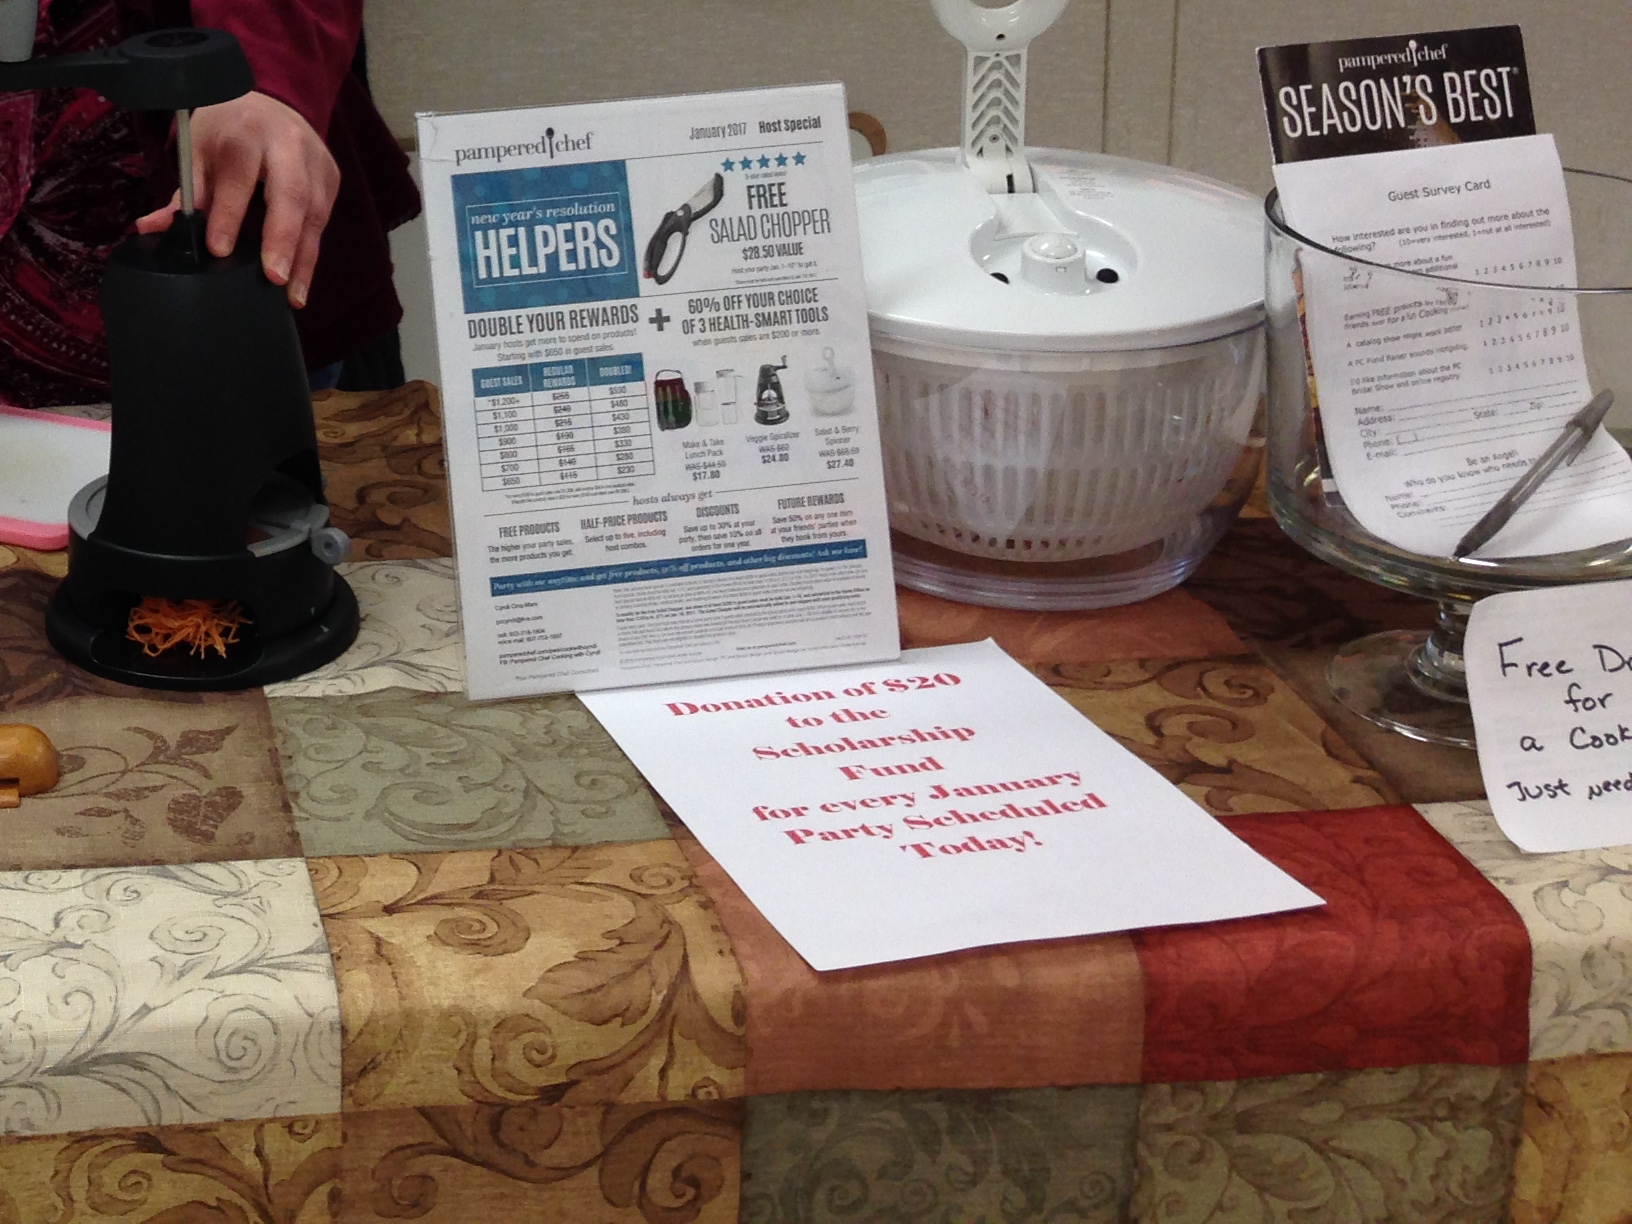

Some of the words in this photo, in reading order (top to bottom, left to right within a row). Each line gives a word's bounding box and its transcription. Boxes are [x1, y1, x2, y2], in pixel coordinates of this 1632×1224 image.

[1338, 46, 1413, 73] pampered
[1417, 43, 1449, 62] chef
[1278, 73, 1437, 138] SEASON'S
[1443, 66, 1515, 124] BEST
[455, 136, 546, 166] pampered
[555, 132, 595, 152] chef
[690, 125, 726, 141] January
[728, 123, 747, 137] 2017
[758, 121, 782, 134] Host
[783, 116, 821, 133] Special
[746, 182, 788, 210] FREE
[1387, 190, 1419, 202] Guest
[1422, 183, 1461, 199] Survey
[1464, 179, 1491, 192] Card
[471, 214, 500, 225] new
[502, 207, 543, 225] year's
[546, 201, 615, 218] resolution
[709, 214, 757, 244] SALAD
[761, 208, 831, 240] CHOPPER
[1332, 234, 1351, 244] How
[1353, 228, 1395, 242] interested
[1397, 227, 1411, 235] are
[1413, 224, 1428, 234] you
[1440, 218, 1469, 230] finding
[1471, 216, 1485, 225] out
[1487, 213, 1509, 222] more
[1511, 210, 1534, 220] about
[474, 218, 620, 279] HELPERS
[742, 244, 775, 261] $28.50
[776, 242, 804, 257] VALUE
[688, 297, 721, 314] 60%
[723, 294, 743, 312] OFF
[745, 291, 775, 309] YOUR
[777, 287, 818, 306] CHOICE
[468, 314, 524, 339] DOUBLE
[526, 311, 566, 333] YOUR
[569, 303, 639, 330] REWARDS
[681, 317, 696, 334] OF
[699, 317, 706, 333] 3
[709, 310, 793, 333] HEALTH-SMART
[795, 306, 829, 324] TOOLS
[1497, 636, 1574, 678] Free
[663, 684, 841, 719] Donation
[845, 679, 880, 702] of
[884, 671, 962, 695] $20
[1563, 681, 1614, 713] for
[785, 712, 824, 730] to
[830, 704, 891, 725] the
[751, 720, 976, 763] Scholarship
[1520, 734, 1544, 752] a
[1568, 723, 1632, 752] Cook
[838, 755, 945, 782] Fund
[750, 798, 810, 824] for
[819, 787, 917, 818] every
[926, 767, 1084, 803] January
[1506, 777, 1571, 802] Just
[782, 816, 896, 849] Party
[901, 791, 1110, 834] Scheduled
[899, 827, 1045, 863] Today!
